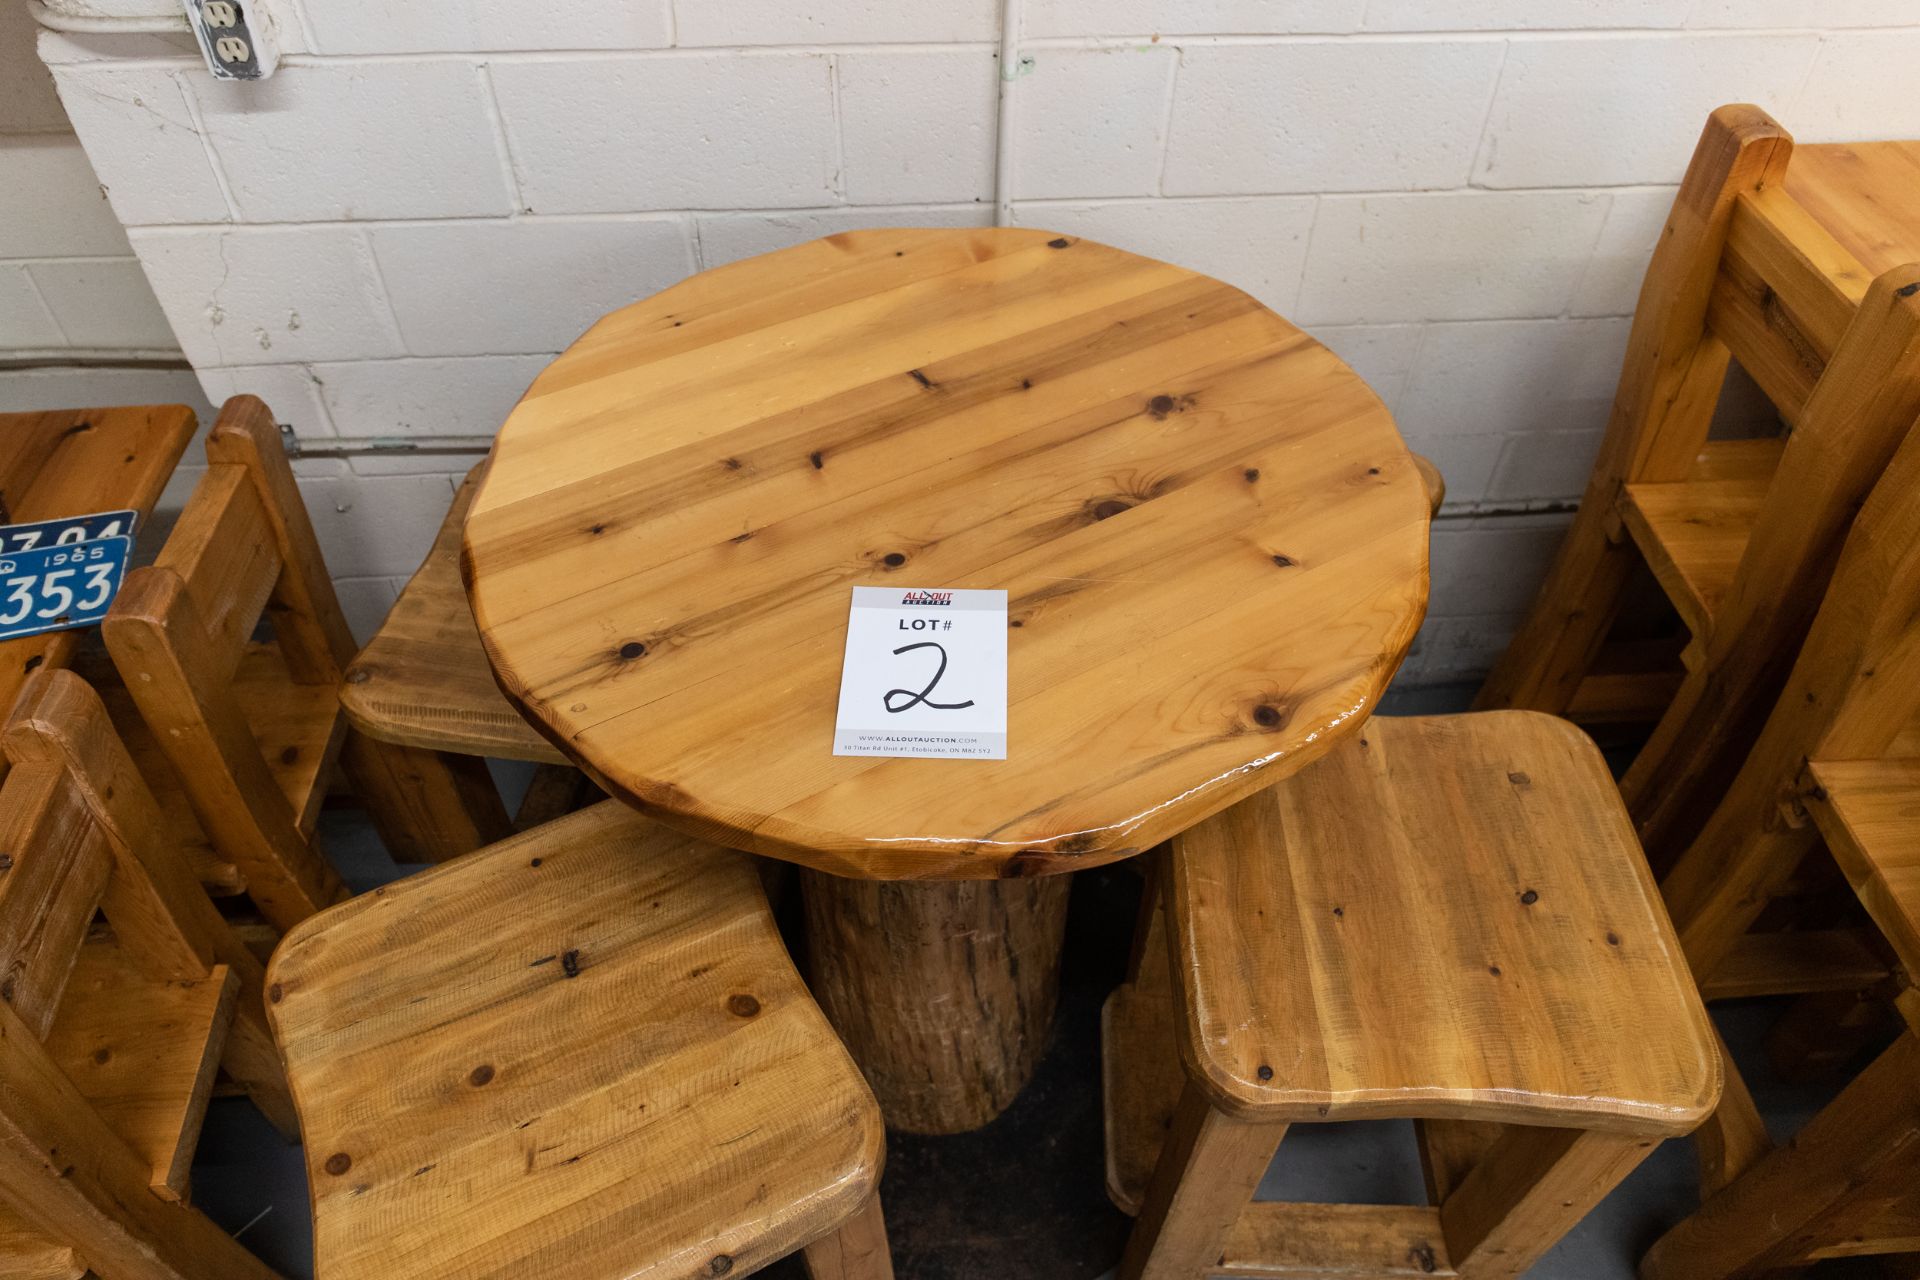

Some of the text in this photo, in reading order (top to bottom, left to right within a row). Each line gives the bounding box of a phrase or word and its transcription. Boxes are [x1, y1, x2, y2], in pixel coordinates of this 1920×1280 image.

[0, 562, 115, 625] 353
[883, 641, 975, 714] 2
[858, 735, 978, 744] WWW.ALLOUTAUCTION.COM
